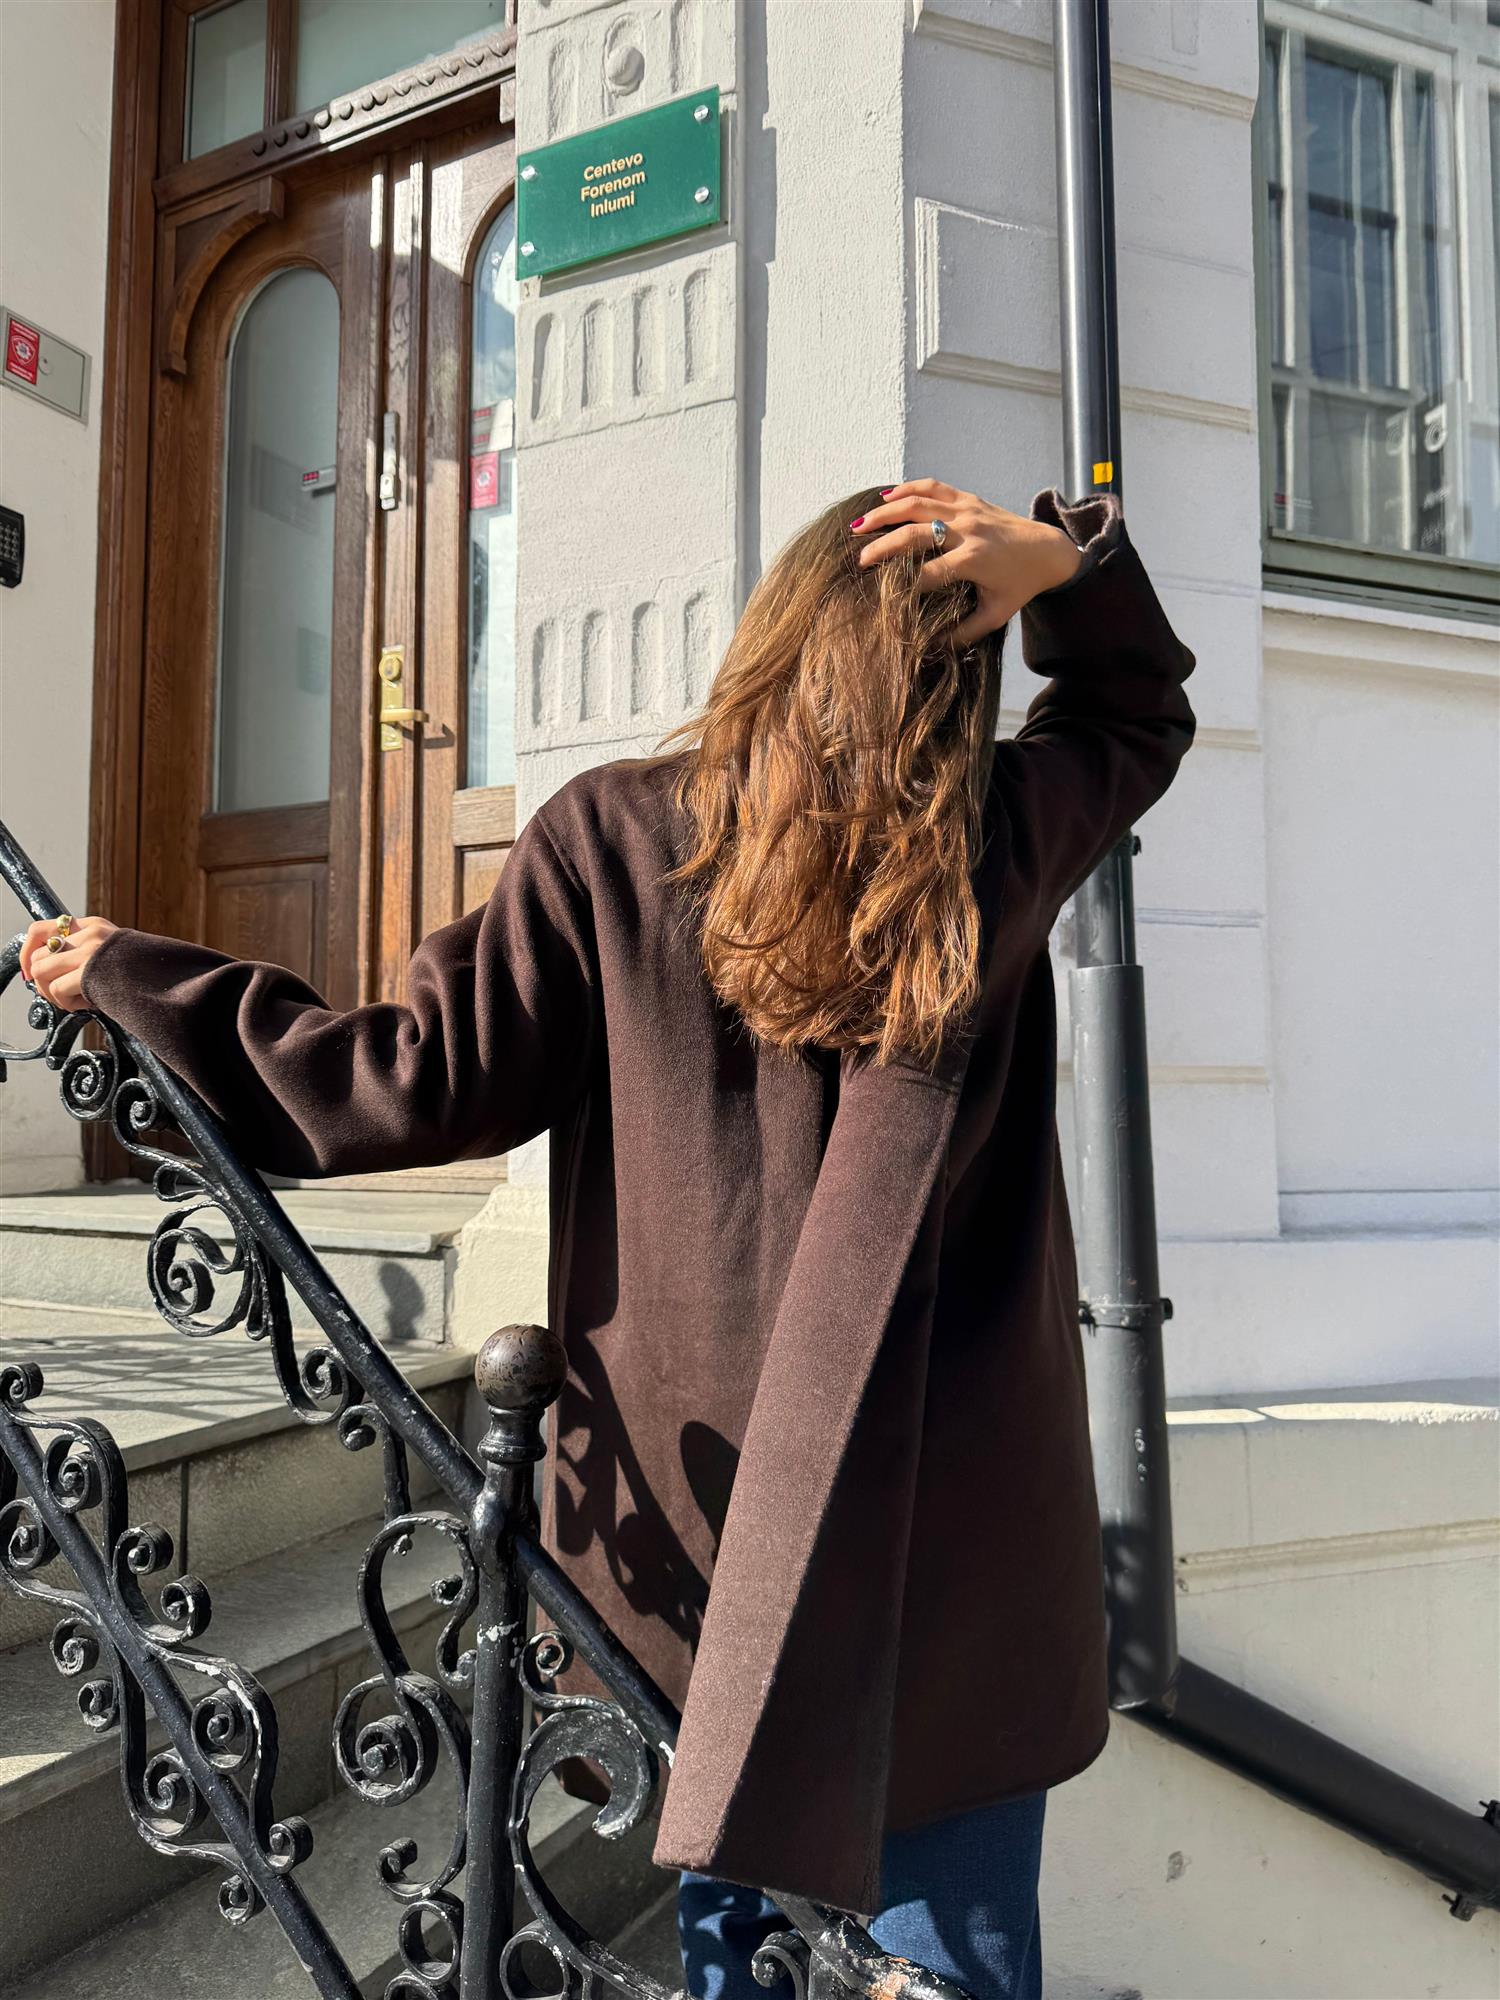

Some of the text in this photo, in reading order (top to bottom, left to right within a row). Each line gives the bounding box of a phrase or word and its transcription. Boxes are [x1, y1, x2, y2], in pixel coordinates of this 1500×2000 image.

[583, 152, 643, 181] Centevo
[580, 170, 646, 202] Forenom
[590, 190, 635, 218] Inlumi
